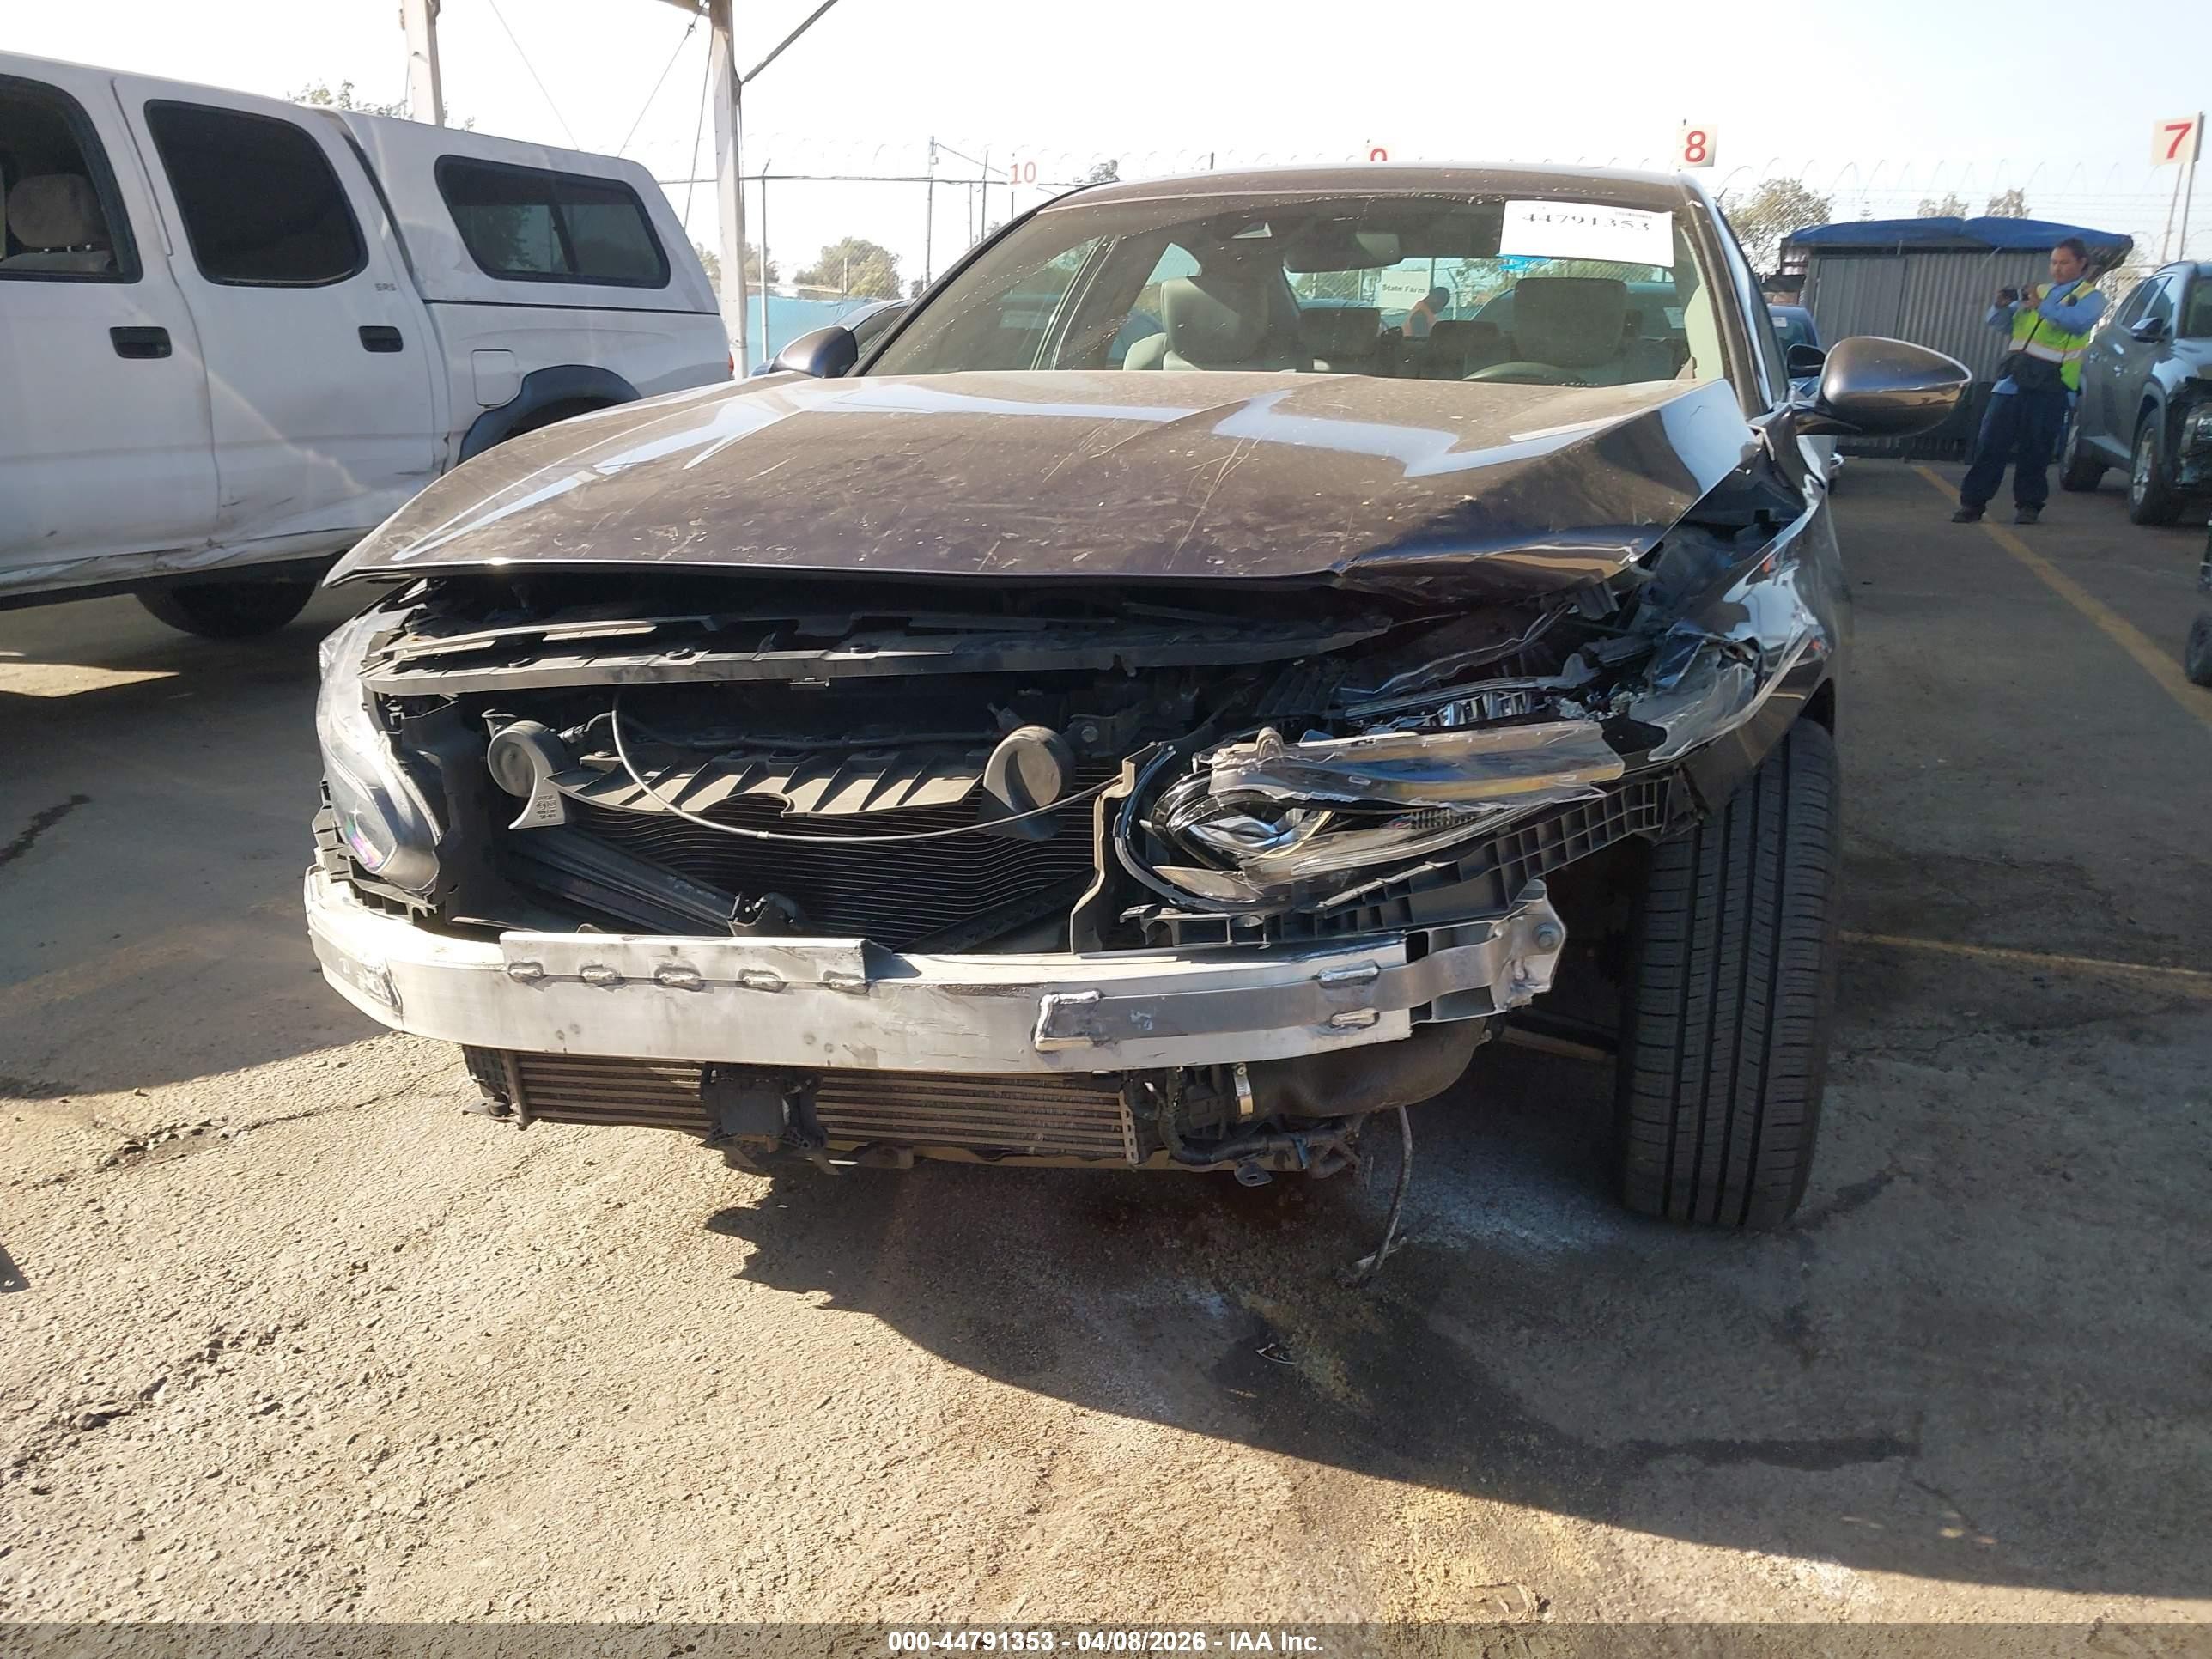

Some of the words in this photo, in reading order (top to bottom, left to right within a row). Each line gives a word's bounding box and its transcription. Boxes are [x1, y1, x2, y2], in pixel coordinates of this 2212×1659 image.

[1685, 131, 1706, 163] 8
[2165, 122, 2192, 159] 7
[1010, 161, 1036, 185] 10
[1522, 213, 1650, 231] 44791353
